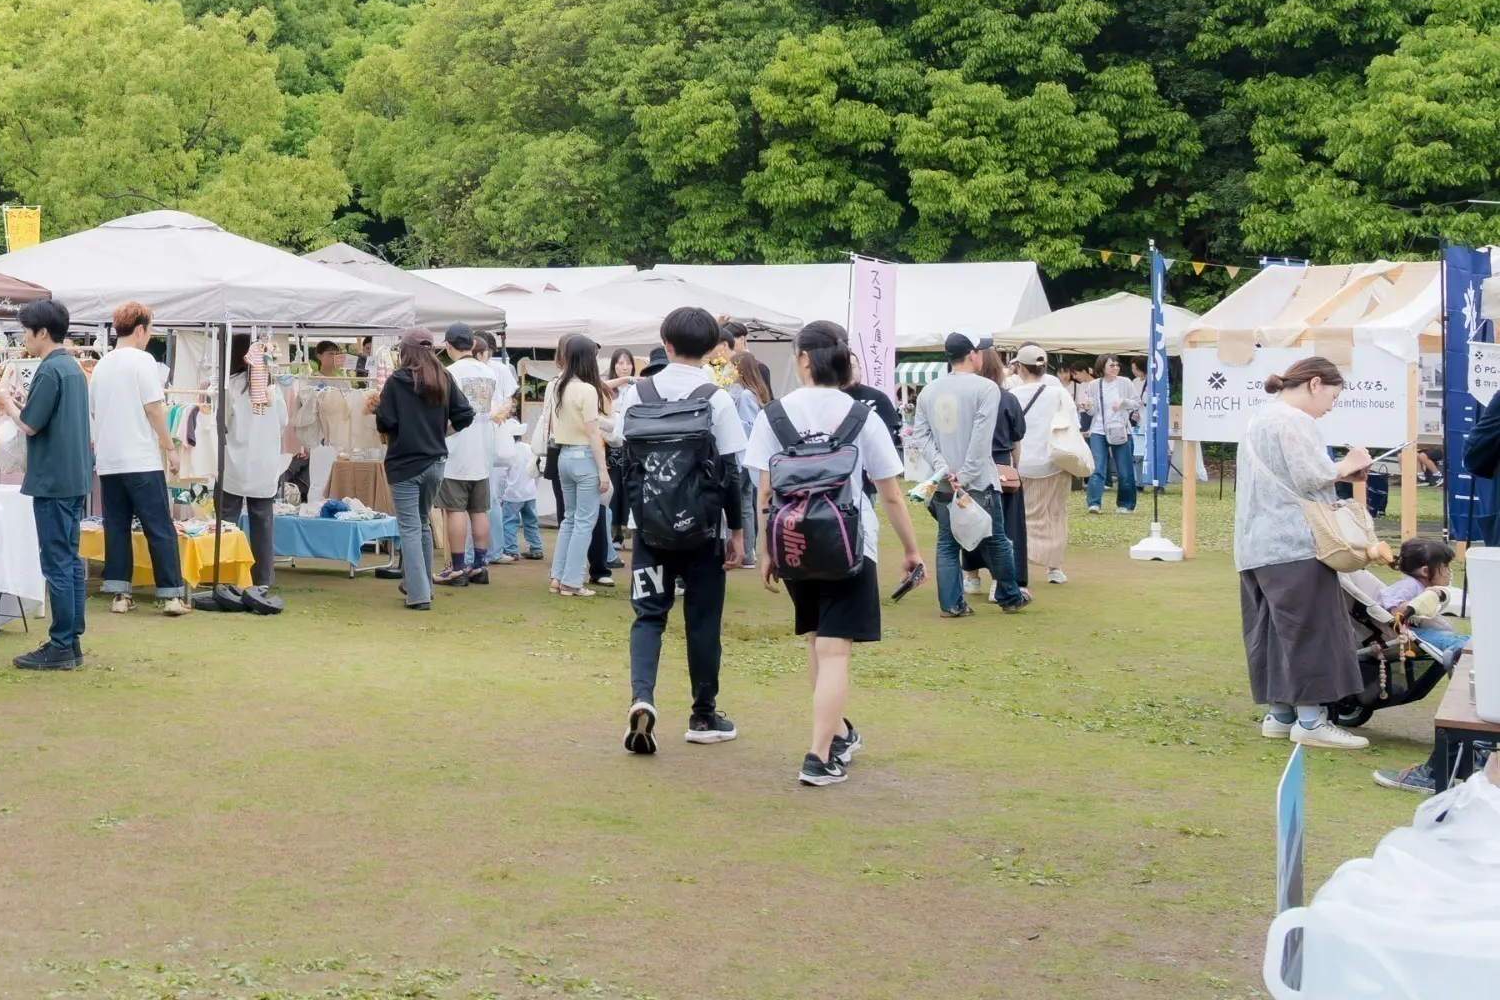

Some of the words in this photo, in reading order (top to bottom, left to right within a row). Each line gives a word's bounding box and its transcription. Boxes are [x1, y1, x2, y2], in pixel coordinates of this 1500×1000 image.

[1193, 396, 1240, 411] ARRCH
[1369, 399, 1395, 409] house
[632, 564, 665, 600] EY
